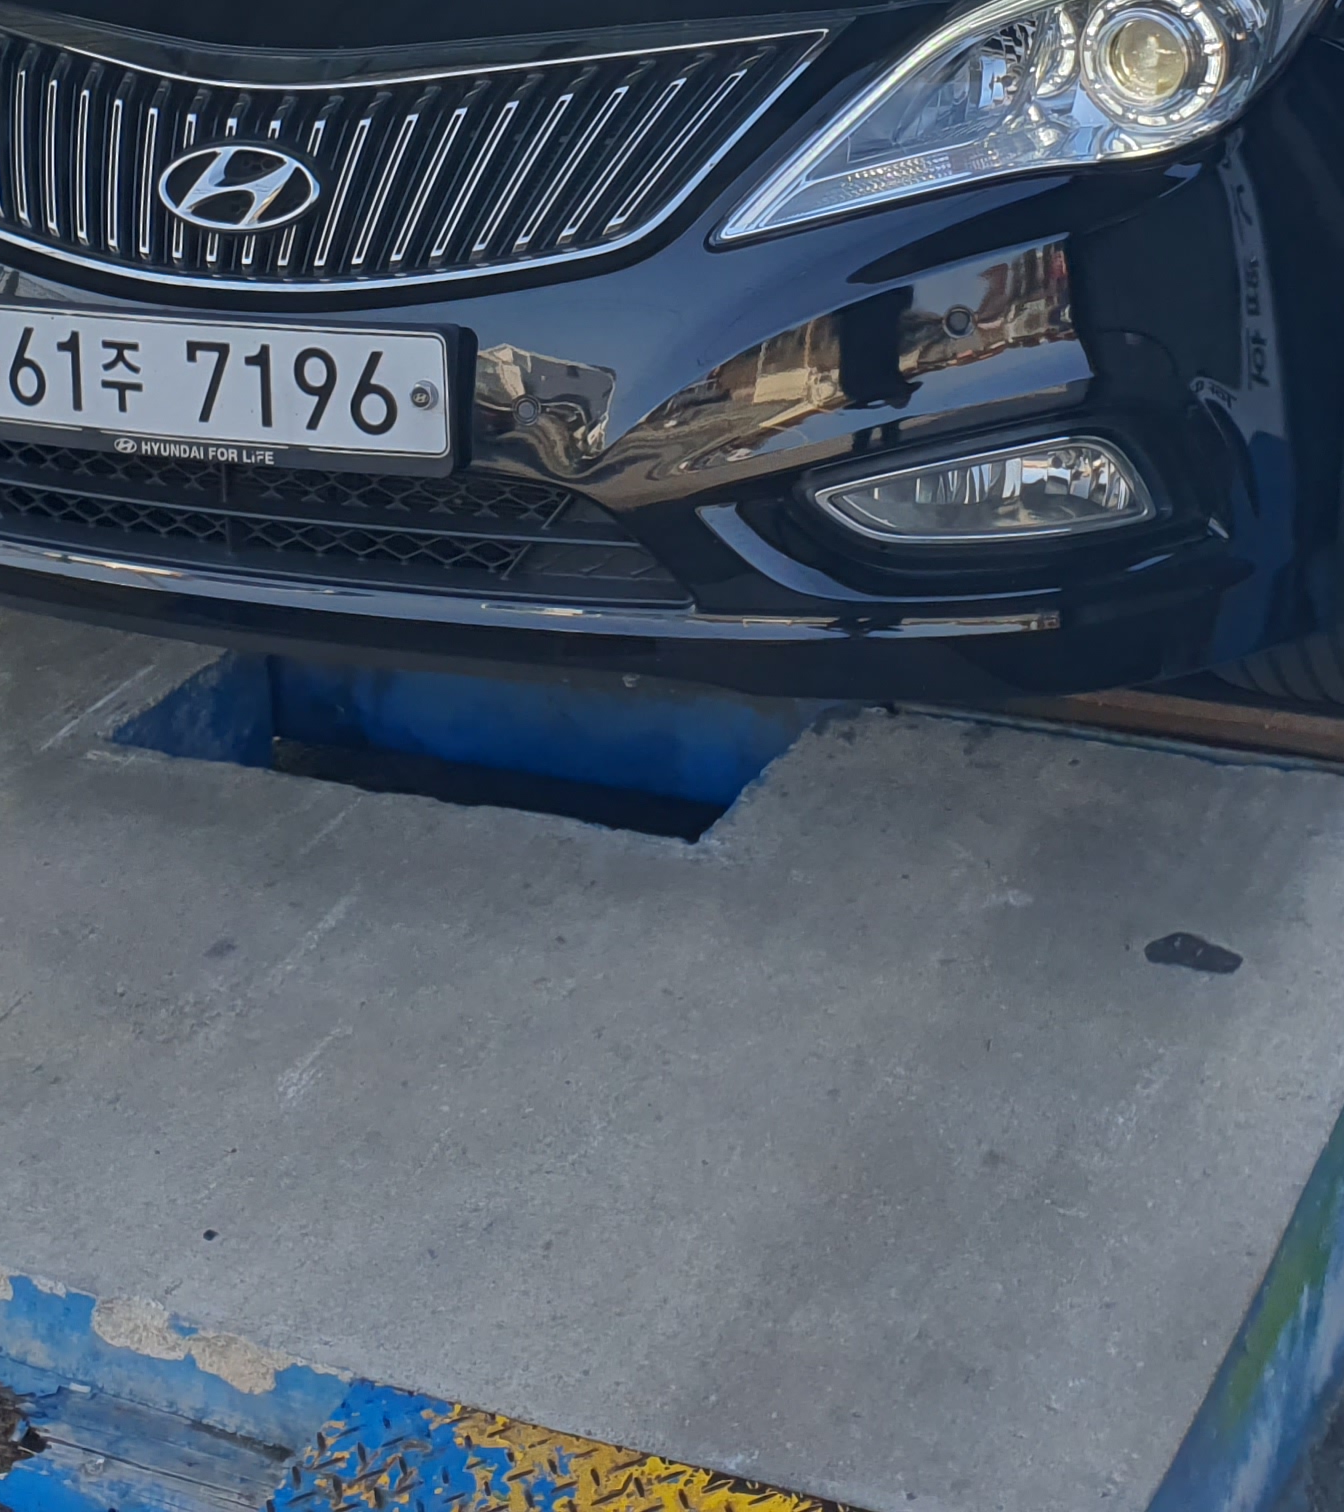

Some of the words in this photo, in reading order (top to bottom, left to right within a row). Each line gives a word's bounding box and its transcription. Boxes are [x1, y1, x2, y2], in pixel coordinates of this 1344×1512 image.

[8, 326, 144, 413] 61주
[185, 340, 398, 436] 7196
[141, 441, 204, 460] HYUNDAI
[208, 447, 238, 462] FOR
